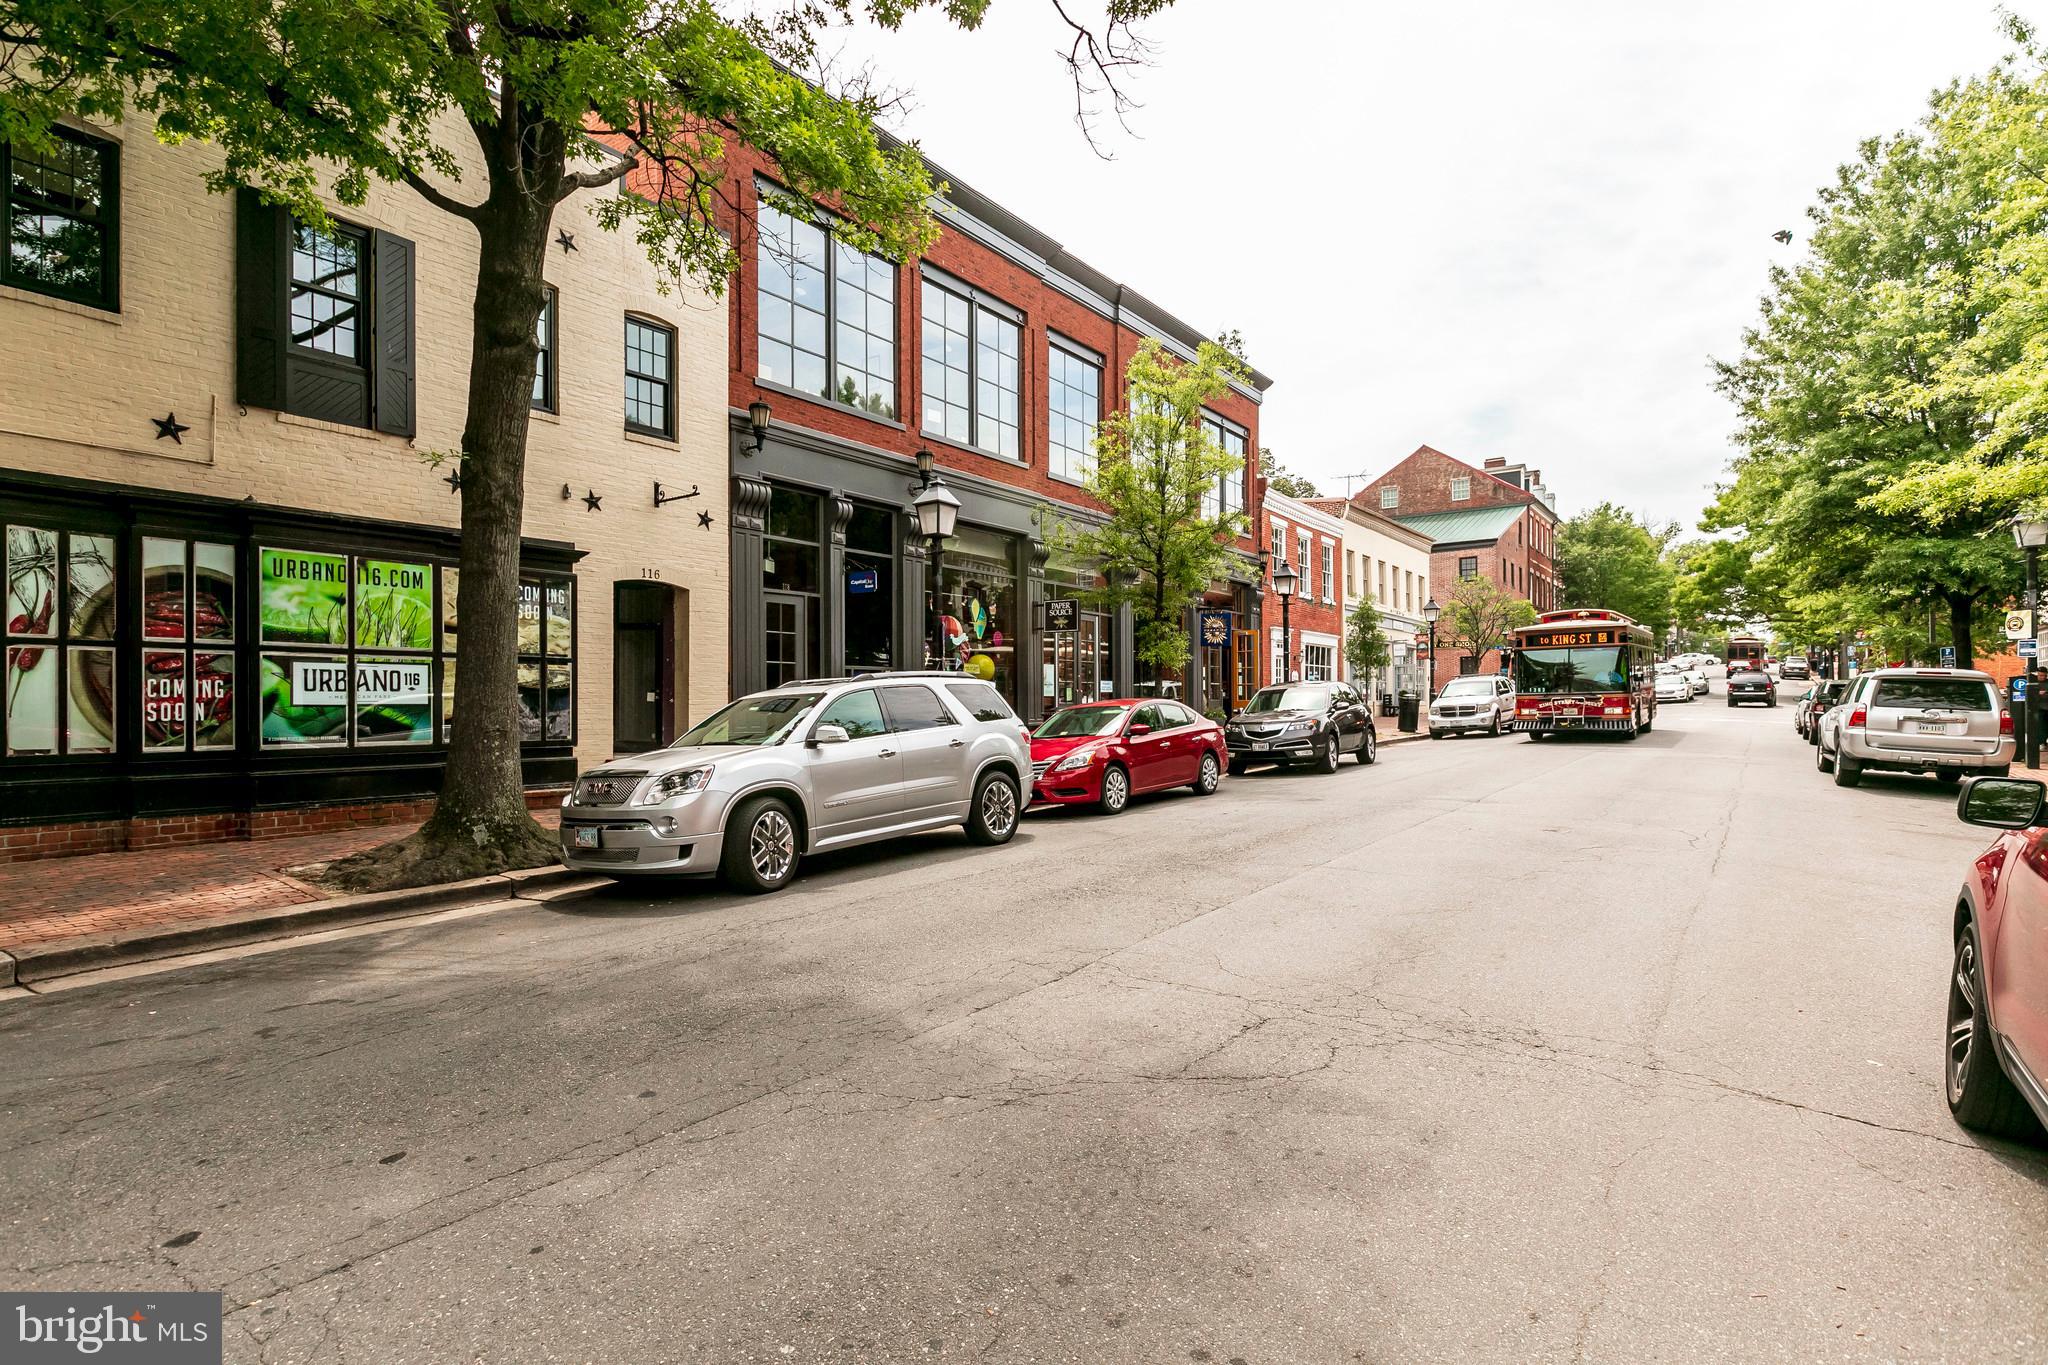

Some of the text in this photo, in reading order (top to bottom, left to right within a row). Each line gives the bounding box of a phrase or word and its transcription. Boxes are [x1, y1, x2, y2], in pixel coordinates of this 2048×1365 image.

[641, 568, 660, 579] 116
[1051, 602, 1071, 610] PAPER
[1049, 608, 1073, 617] SOURCE
[1552, 635, 1576, 645] KING
[1579, 634, 1592, 643] ST
[303, 668, 420, 692] URBANO 116
[147, 679, 224, 698] COMING
[147, 702, 205, 722] SOON
